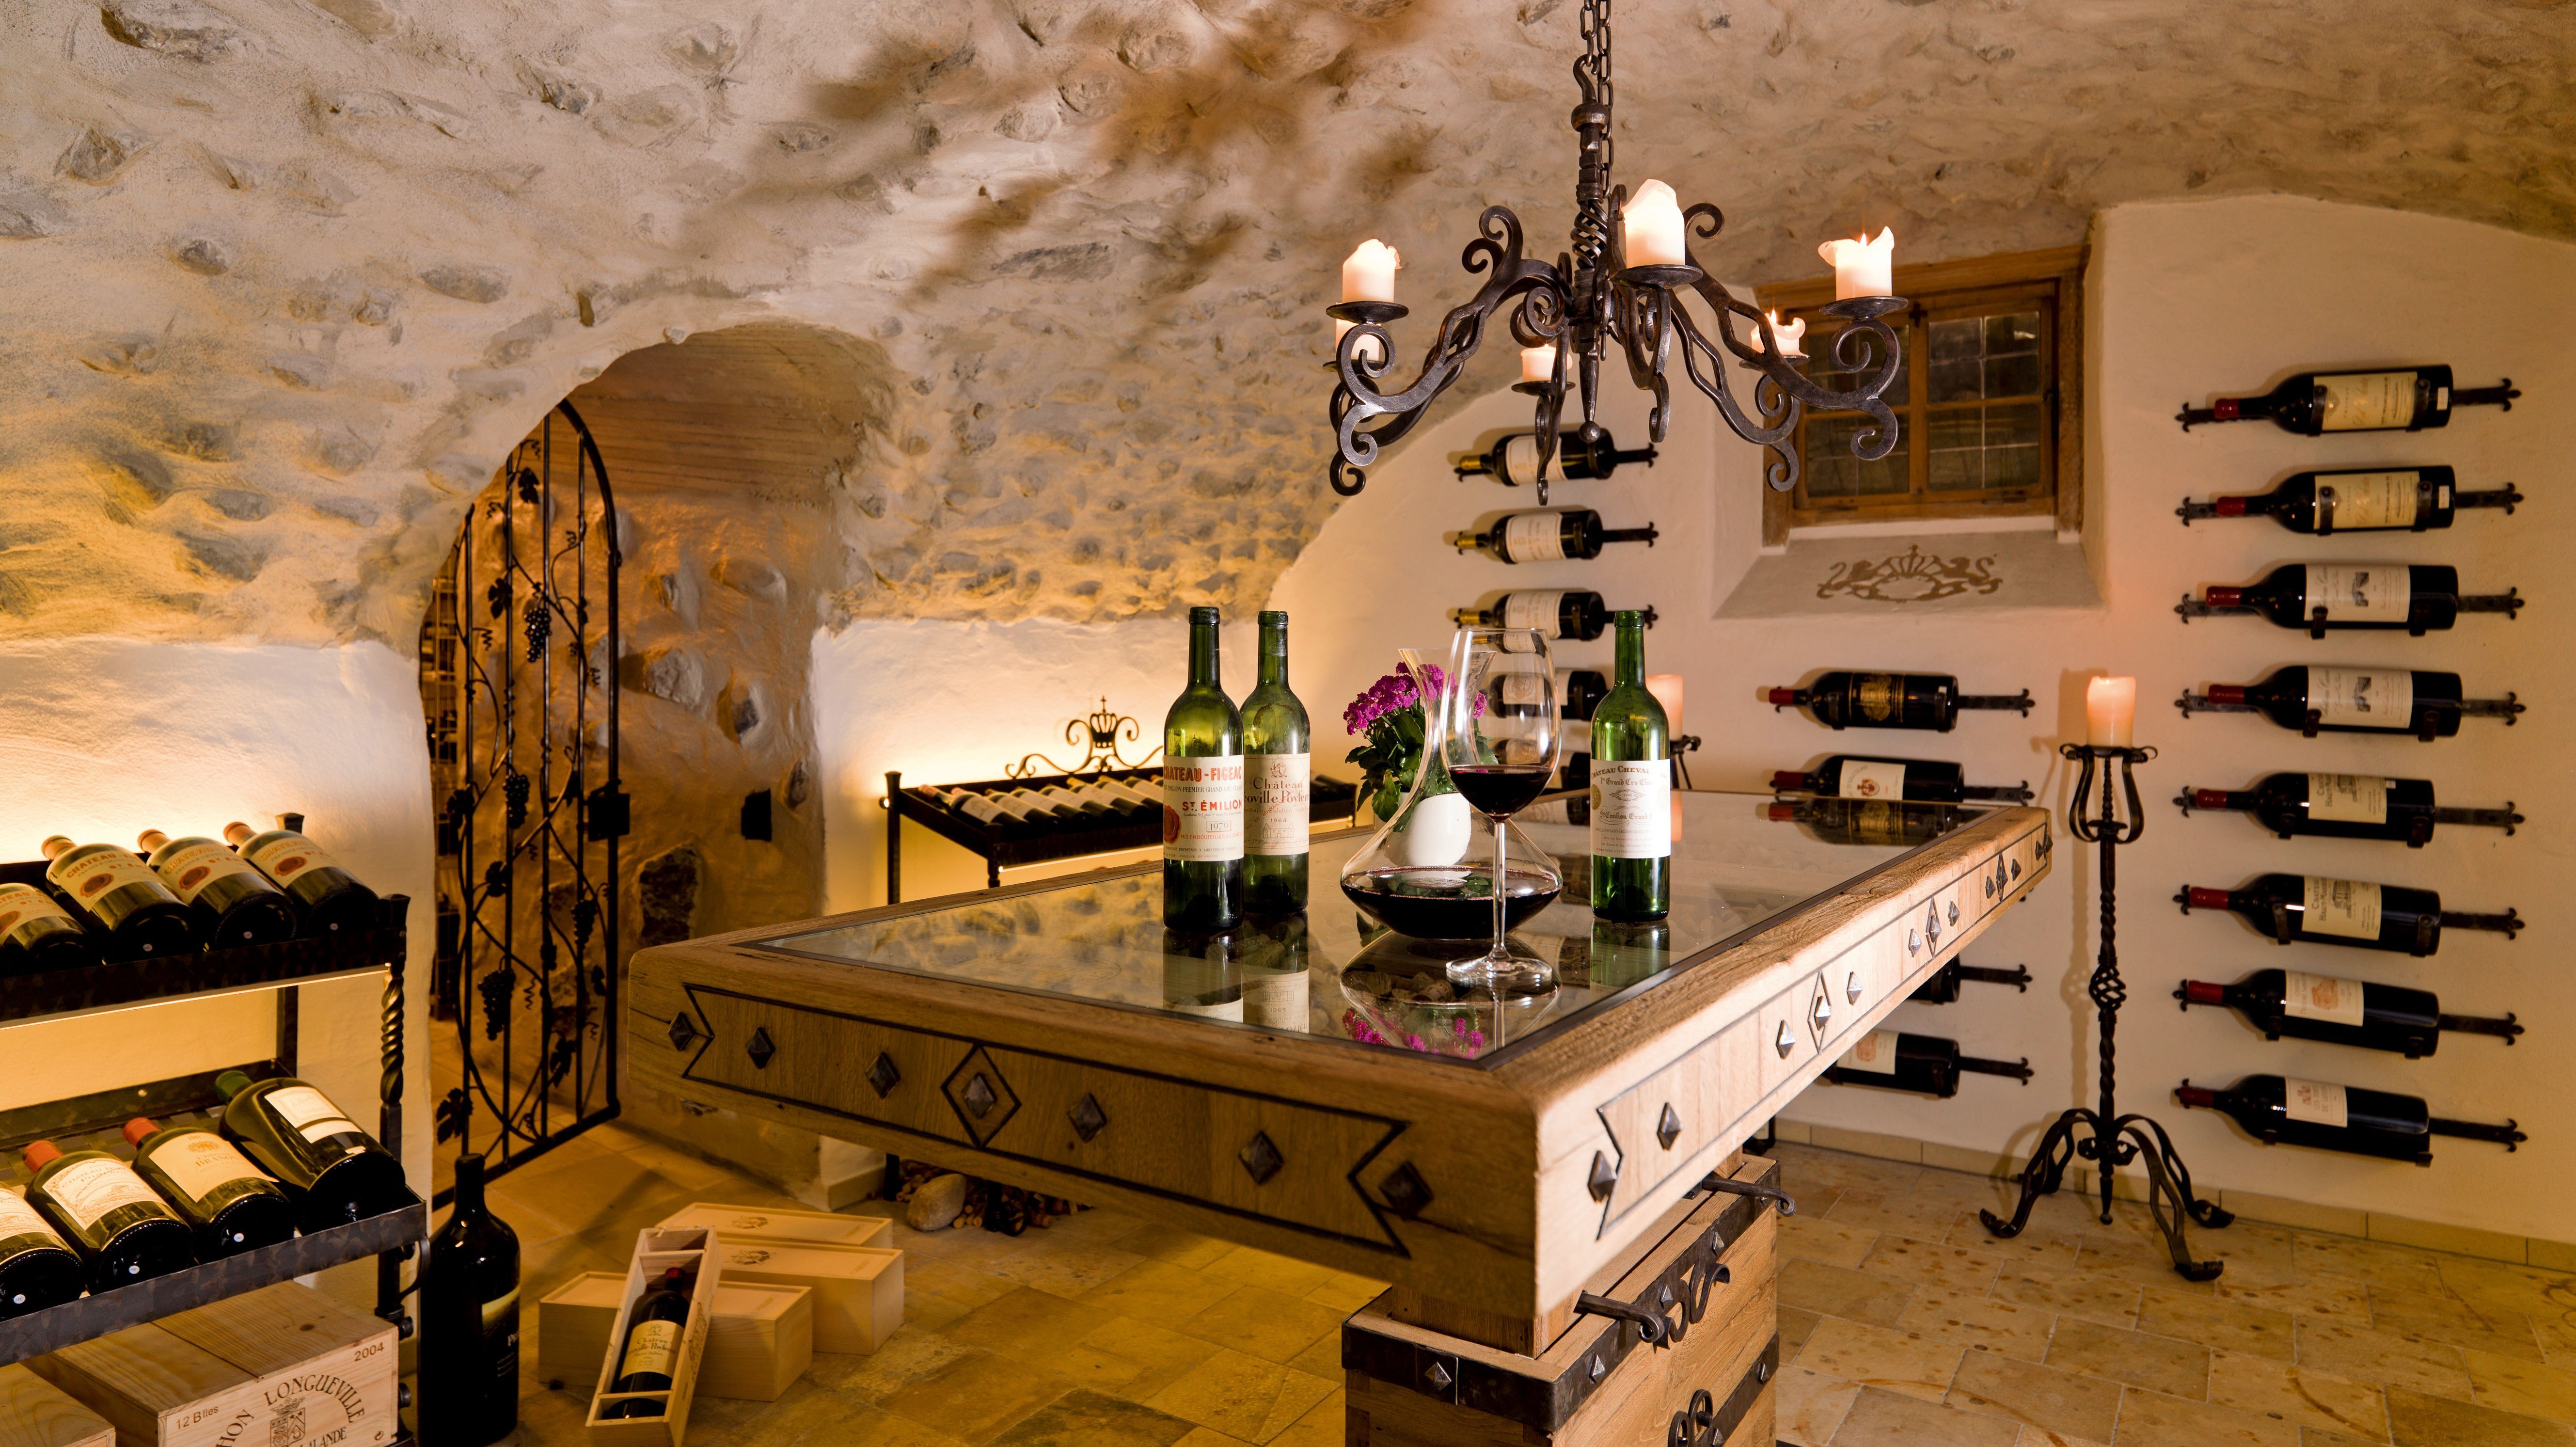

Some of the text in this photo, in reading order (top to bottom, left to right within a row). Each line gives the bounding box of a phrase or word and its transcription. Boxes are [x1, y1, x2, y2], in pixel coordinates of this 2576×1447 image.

[1253, 777, 1302, 789] Château
[1201, 799, 1242, 811] ÉMILION
[1244, 790, 1278, 803] éoville
[1209, 822, 1229, 830] 1979
[66, 853, 116, 878] CHATEAU
[354, 1341, 385, 1361] 2004
[264, 1374, 366, 1423] LONGUEVILLE
[176, 1416, 190, 1430] 12
[215, 1409, 254, 1447] HON
[300, 1427, 347, 1447] ALANDE
